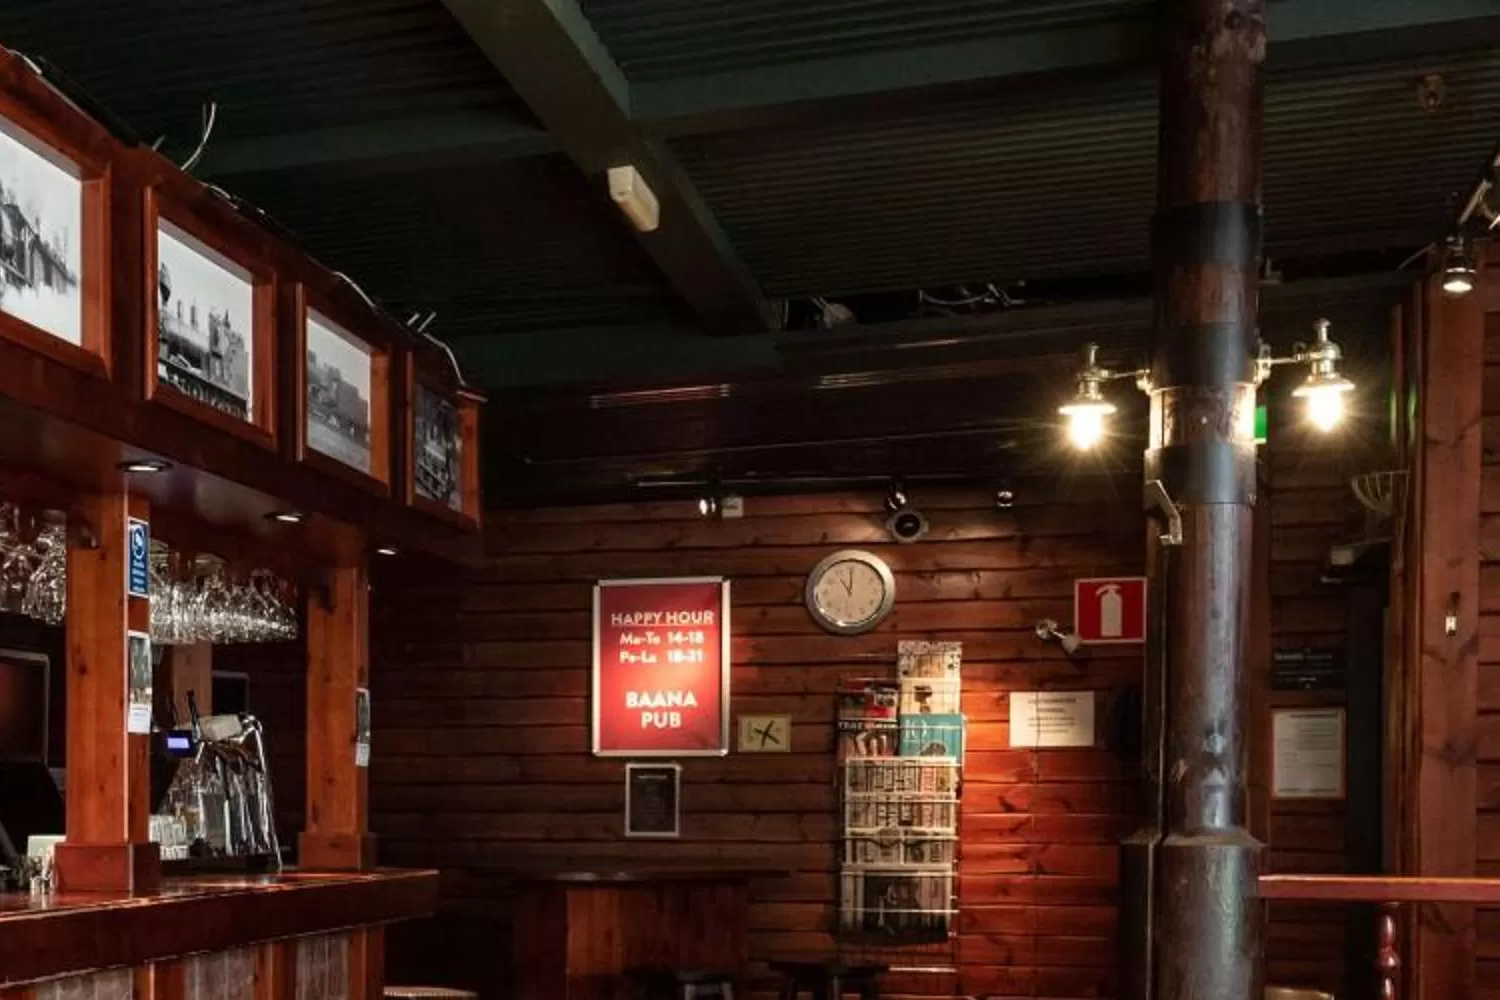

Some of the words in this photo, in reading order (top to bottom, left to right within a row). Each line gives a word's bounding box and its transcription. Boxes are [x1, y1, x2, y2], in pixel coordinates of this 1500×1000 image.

[611, 612, 661, 625] HAPPY
[666, 610, 714, 625] HOUR
[625, 691, 698, 709] BAANA
[641, 711, 682, 728] PUB
